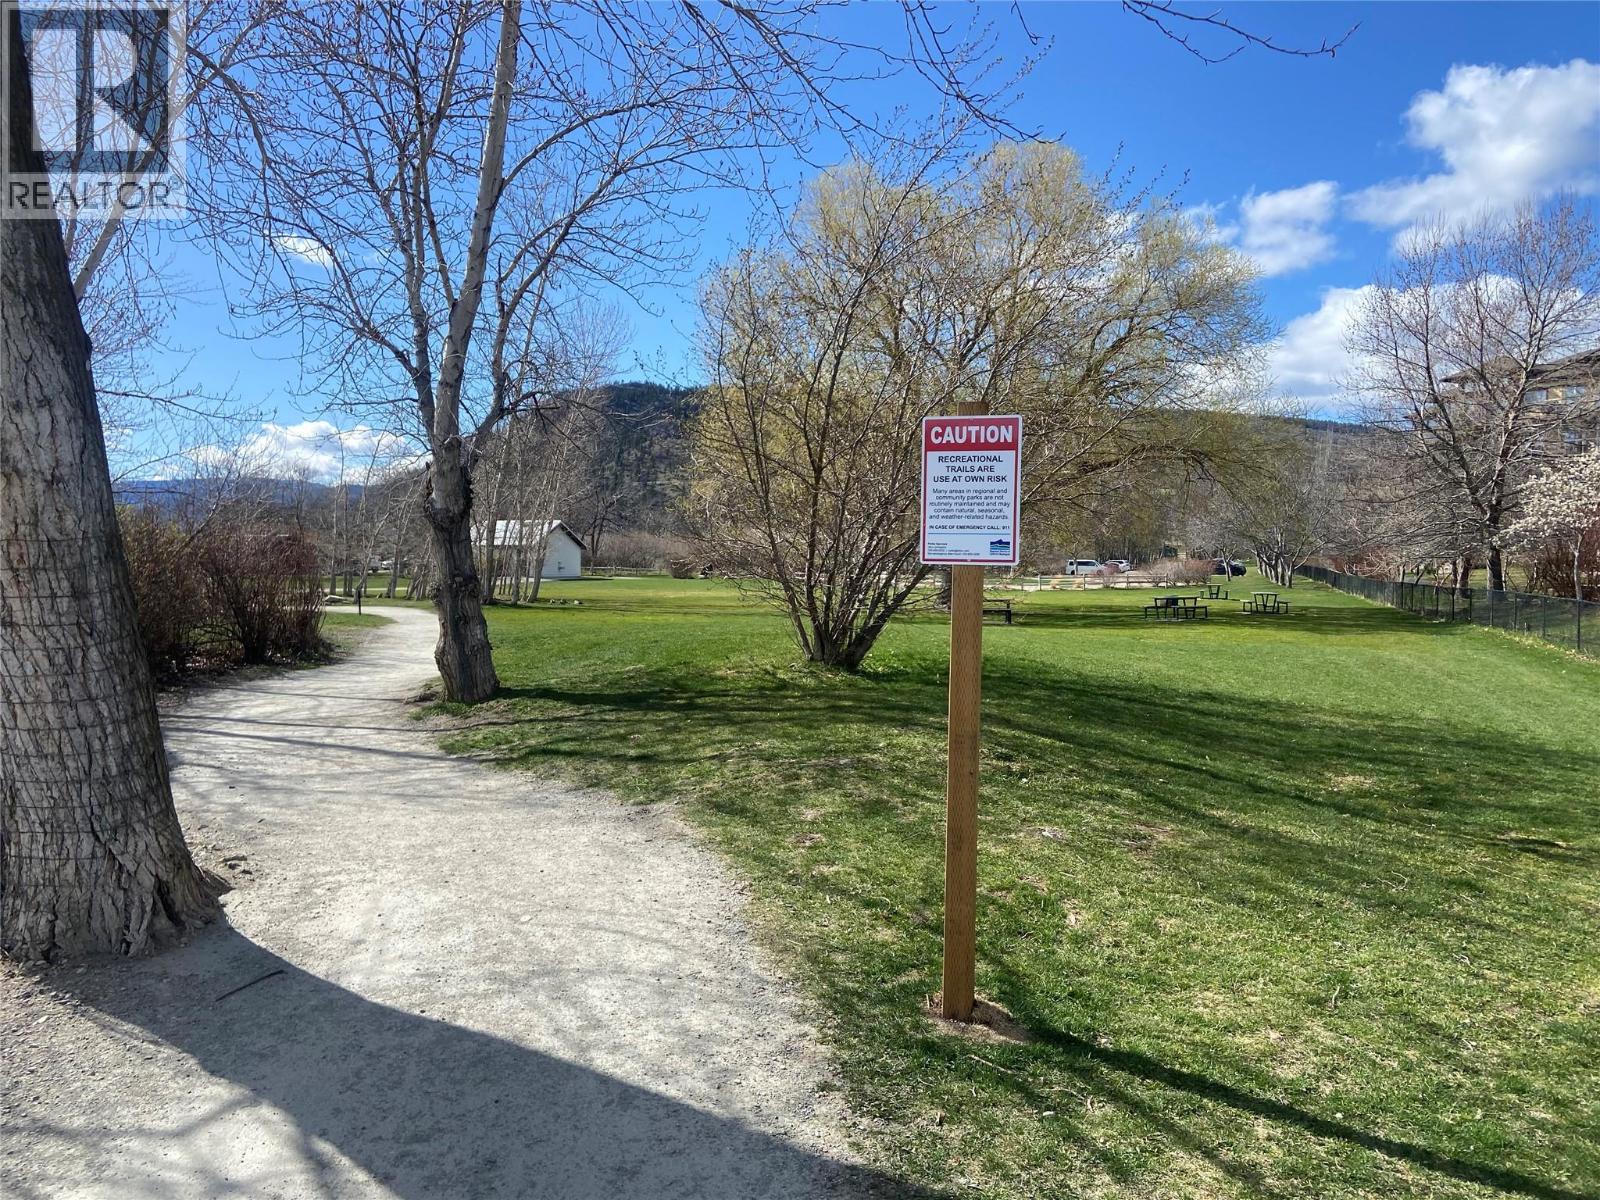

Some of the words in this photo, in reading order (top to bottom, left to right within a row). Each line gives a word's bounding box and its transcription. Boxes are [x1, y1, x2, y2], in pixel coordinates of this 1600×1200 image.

[930, 425, 1013, 444] CAUTION
[938, 455, 1003, 463] RECREATIONAL
[946, 465, 975, 473] TRAILS
[977, 465, 995, 473] ARE
[964, 475, 984, 483] OWN
[987, 475, 1007, 483] RISK
